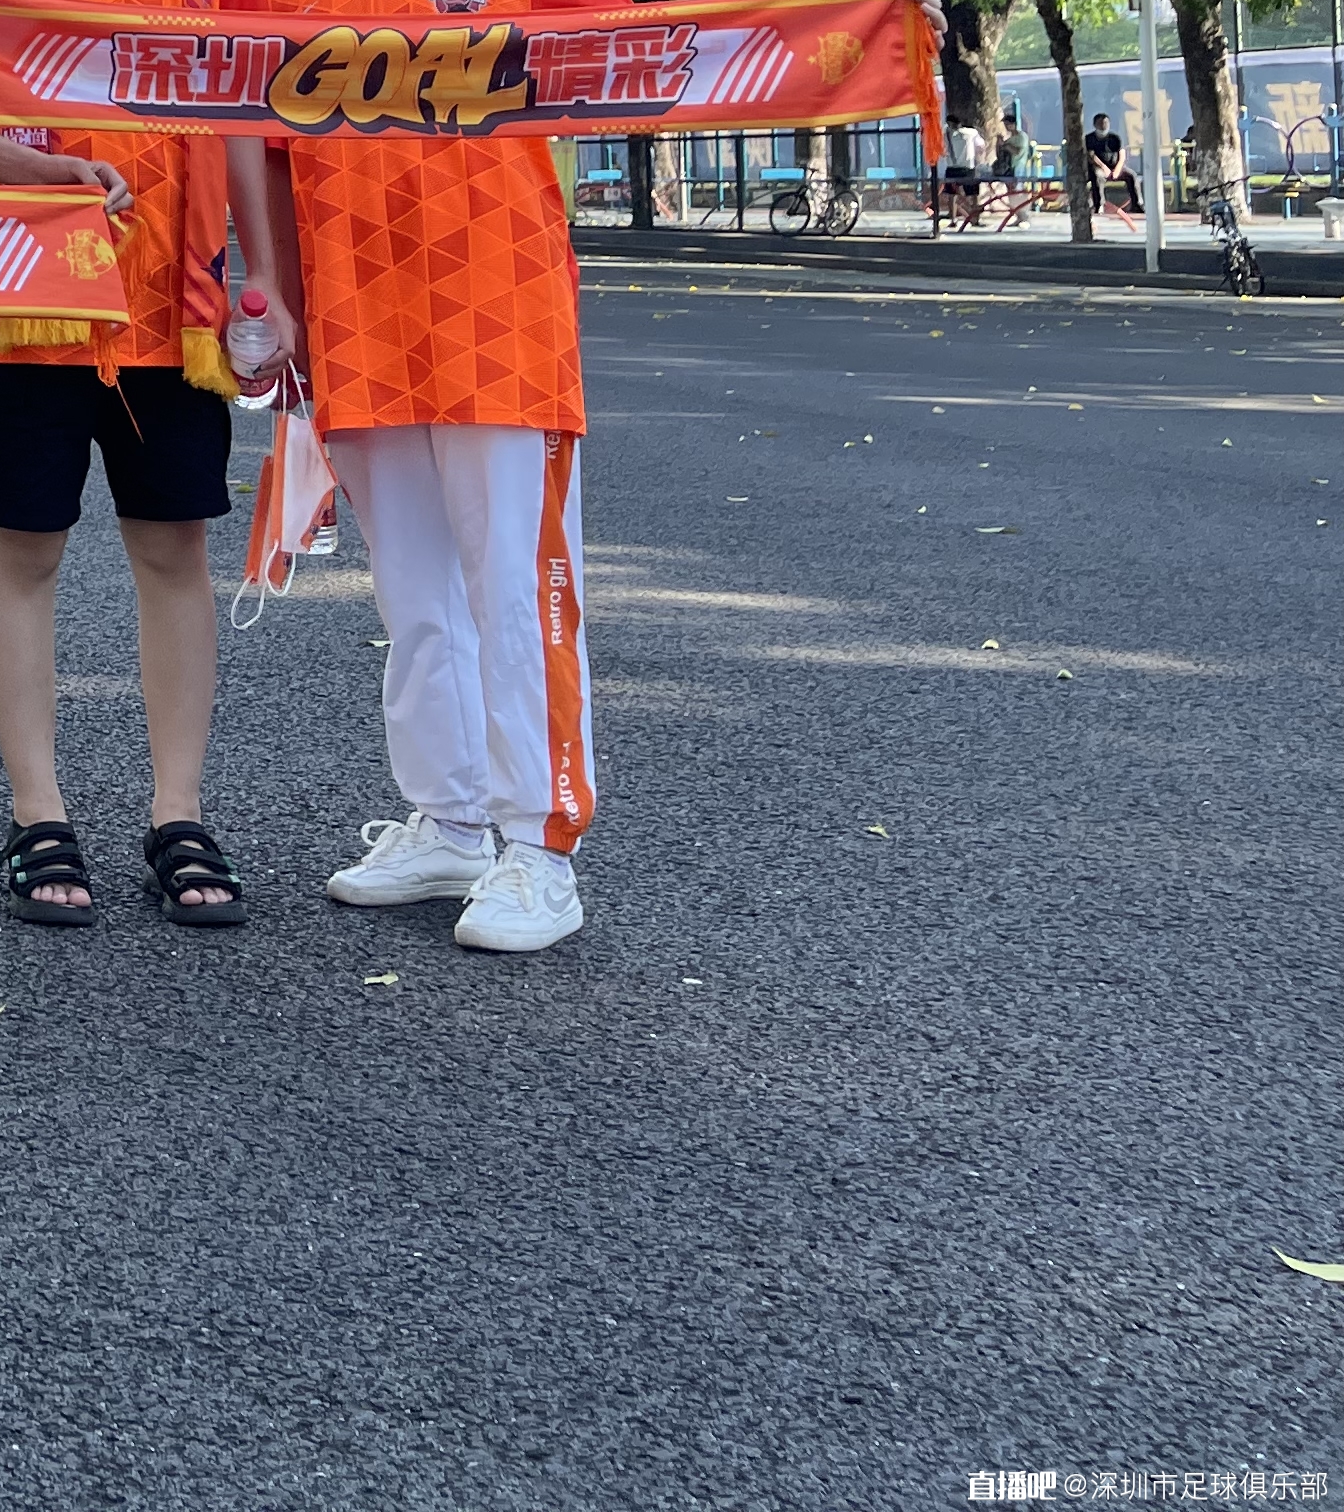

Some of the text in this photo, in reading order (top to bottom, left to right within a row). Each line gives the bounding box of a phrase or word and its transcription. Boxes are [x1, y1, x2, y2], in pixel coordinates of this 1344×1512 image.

[110, 24, 697, 126] 深圳 GOAL 精彩
[547, 556, 567, 646] Retro girl
